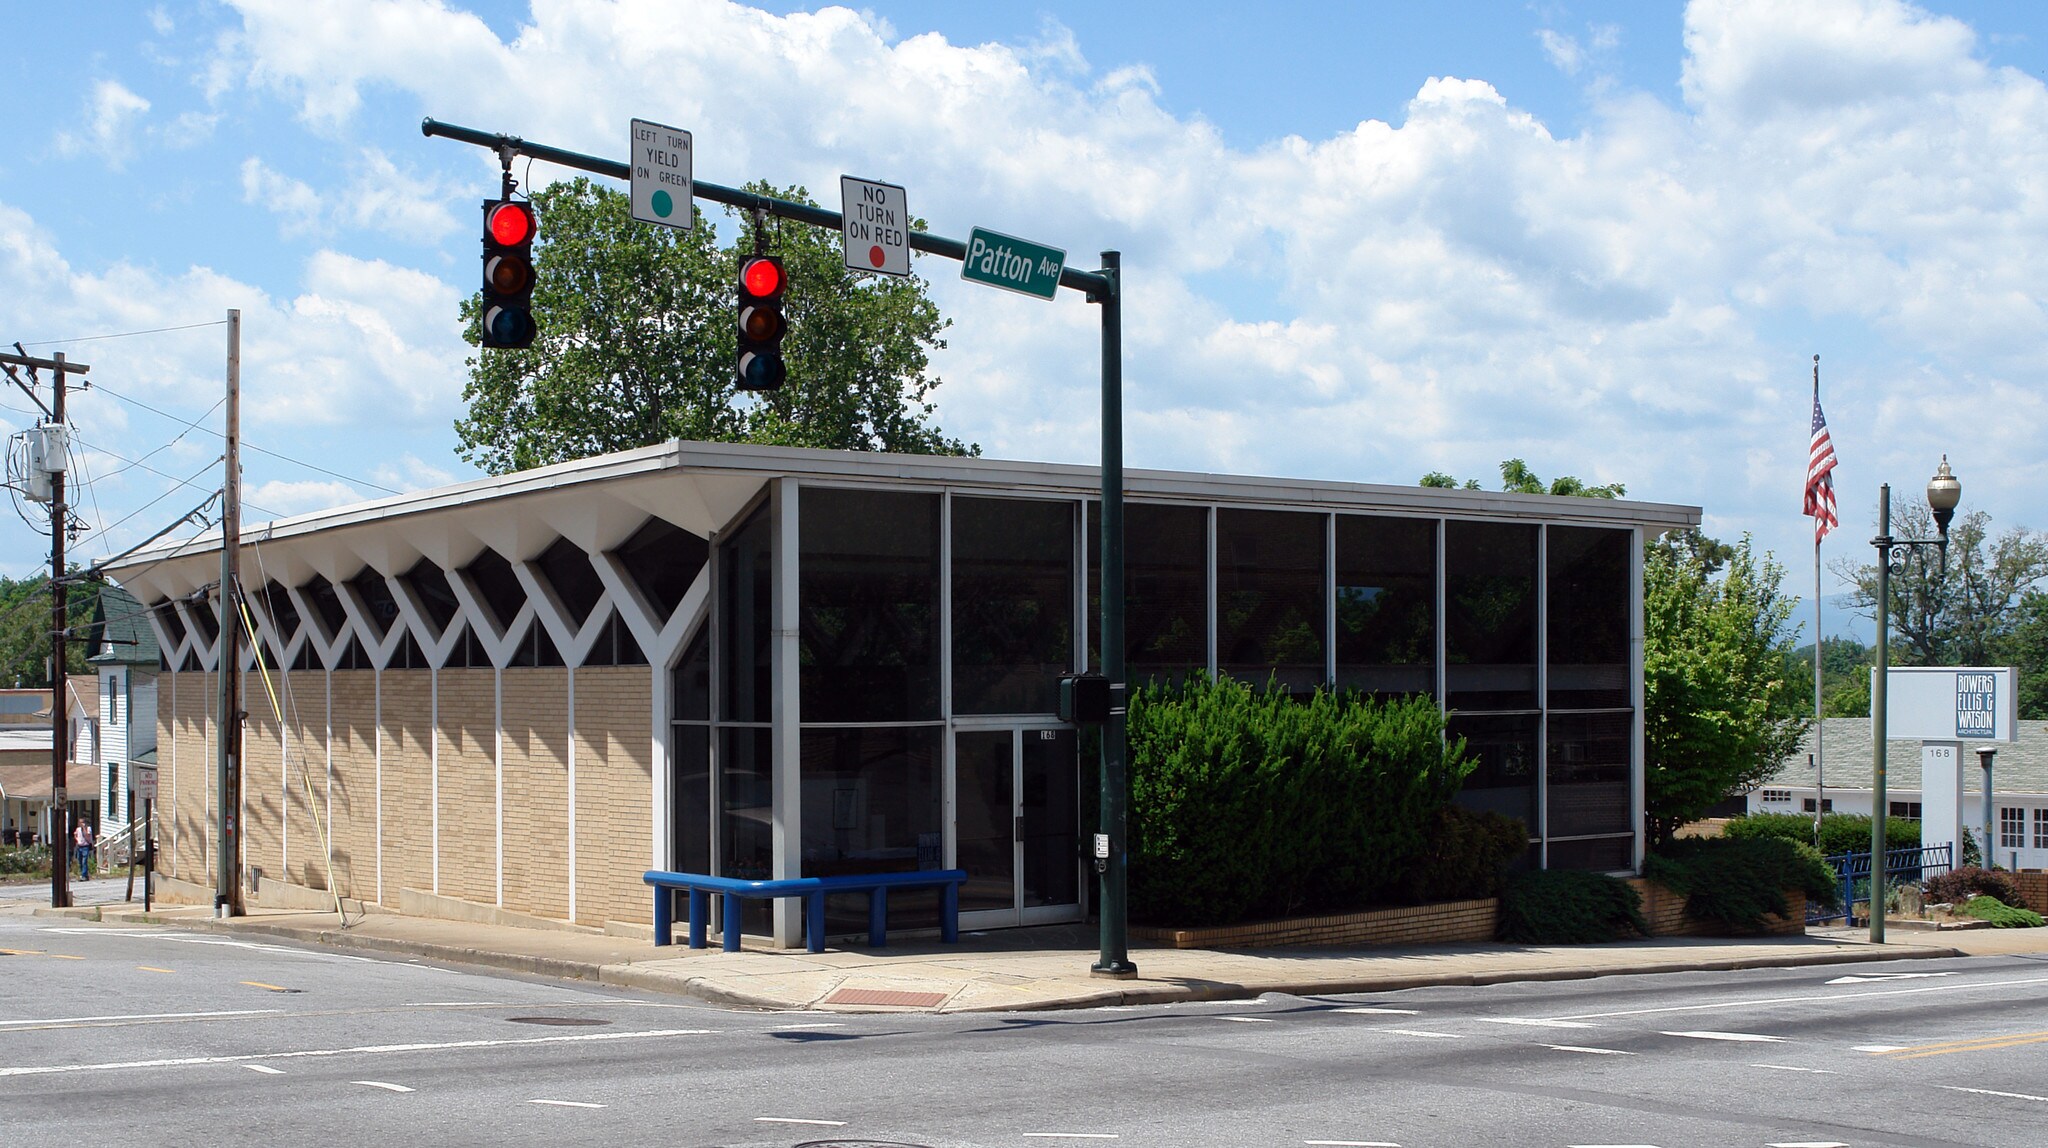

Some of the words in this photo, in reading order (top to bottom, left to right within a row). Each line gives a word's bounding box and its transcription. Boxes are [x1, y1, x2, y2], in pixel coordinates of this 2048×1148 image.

[635, 128, 657, 143] LEFT
[667, 135, 688, 151] TURN
[646, 148, 679, 168] YIELD
[637, 166, 650, 179] ON
[659, 171, 687, 187] GREEN
[863, 185, 886, 205] NO
[857, 203, 895, 227] TURN
[850, 221, 869, 241] ON
[875, 226, 903, 247] RED
[967, 237, 1033, 284] Patton
[1037, 256, 1059, 278] Ave
[1957, 675, 1993, 693] BOWERS
[1957, 693, 1982, 711] ELLIS
[1986, 693, 1993, 711] &
[1957, 711, 1993, 729] WATSON
[1042, 731, 1055, 739] 168
[1930, 748, 1950, 758] 168
